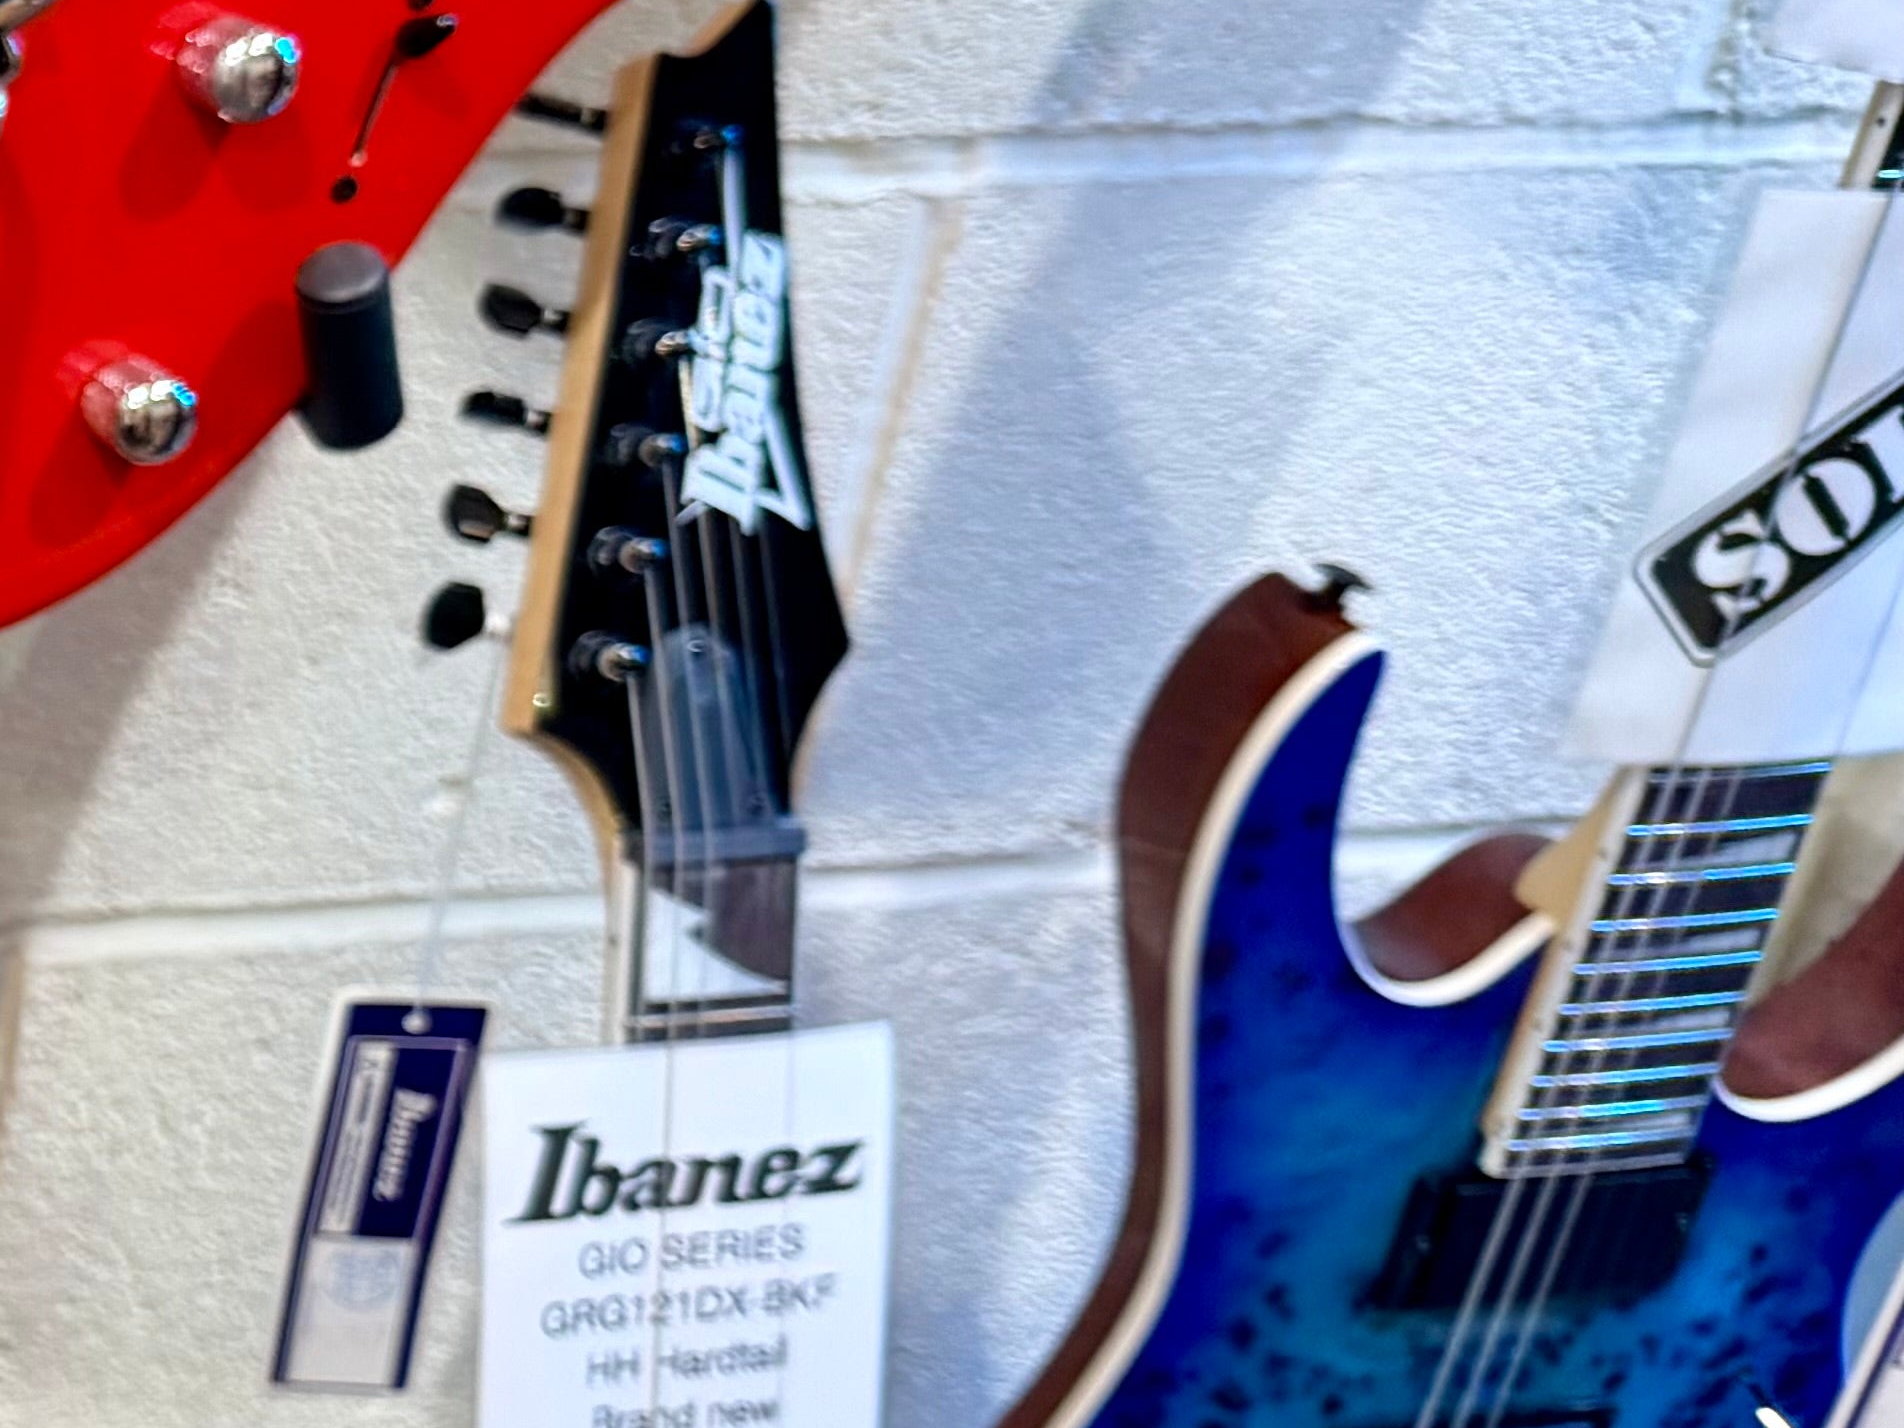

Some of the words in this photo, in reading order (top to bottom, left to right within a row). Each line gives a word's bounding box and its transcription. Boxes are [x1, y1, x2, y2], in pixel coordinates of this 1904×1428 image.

[682, 232, 786, 535] Ibanez
[503, 1119, 867, 1227] Ibanez
[578, 1236, 650, 1280] GIO
[658, 1222, 806, 1270] SERIES
